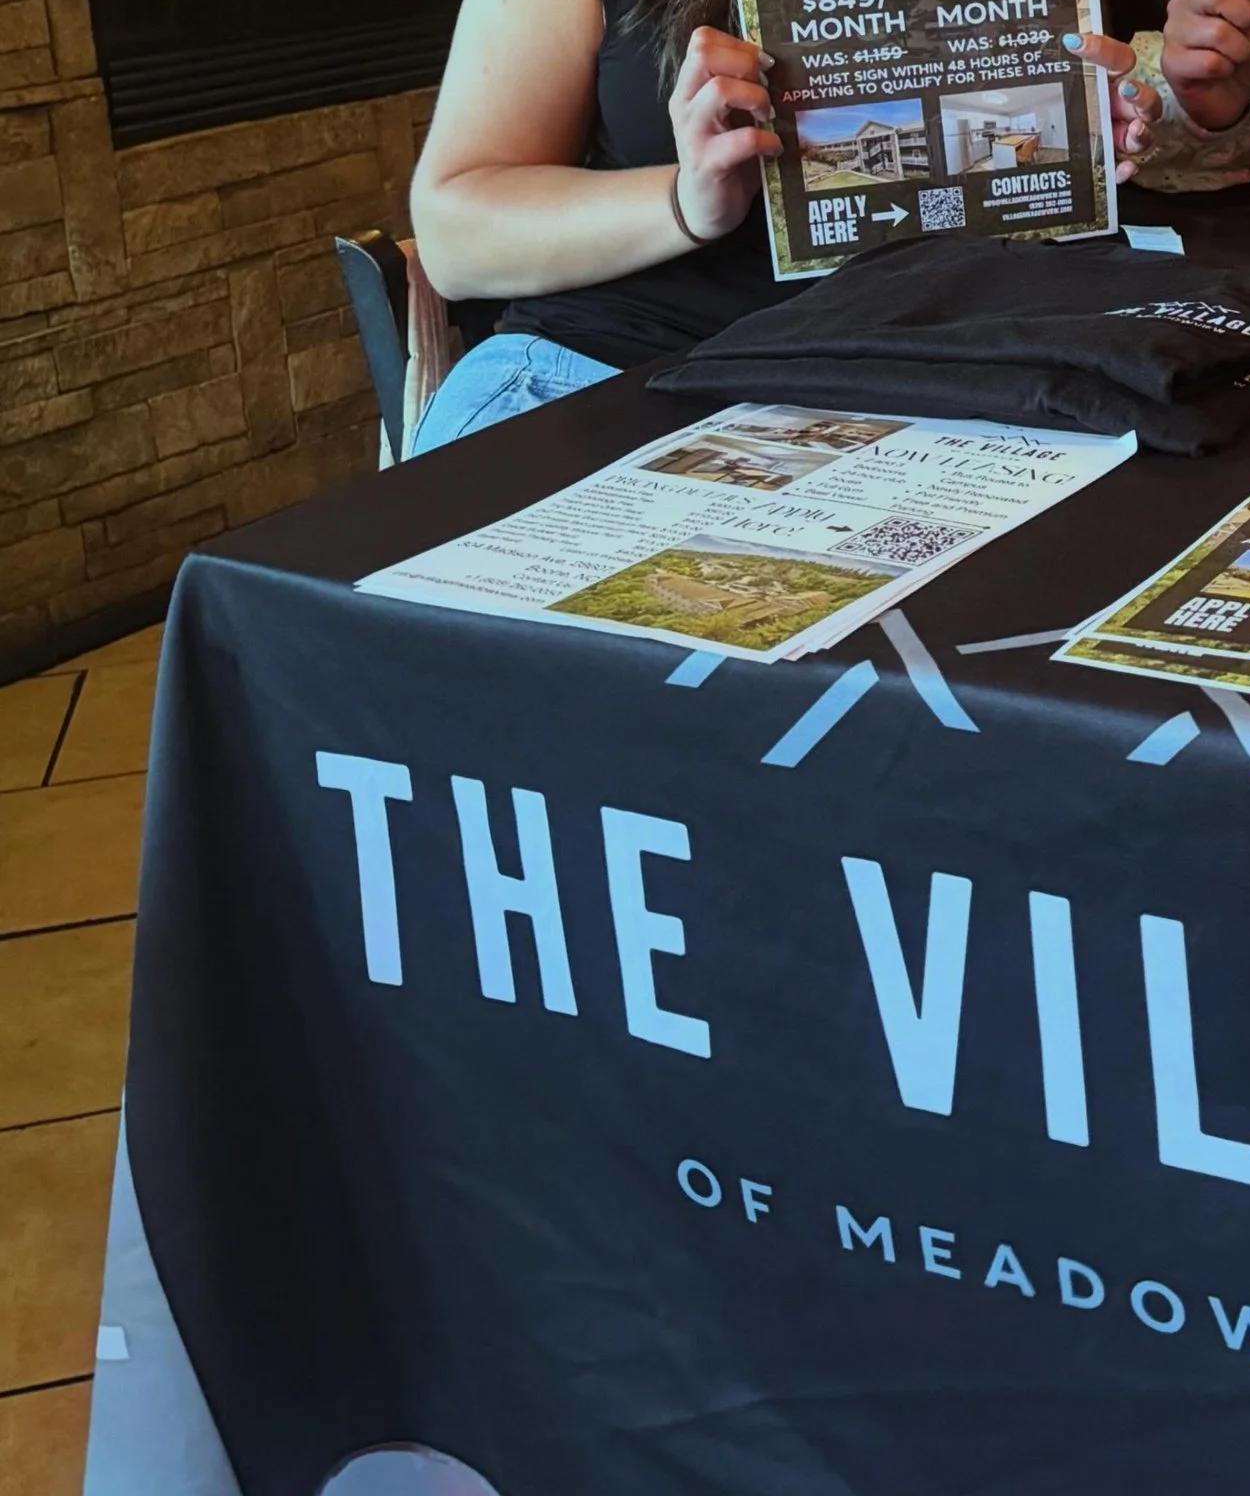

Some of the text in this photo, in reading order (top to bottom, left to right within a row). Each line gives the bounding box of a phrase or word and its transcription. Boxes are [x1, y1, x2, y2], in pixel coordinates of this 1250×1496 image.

[791, 10, 906, 45] MONTH
[947, 37, 993, 54] WAS:
[801, 52, 849, 69] WAS:
[808, 51, 1042, 87] MUST SIGN WITHIN 48 HOURS OF
[782, 60, 1072, 104] APPLYING TO QUALIFY FOR THESE RATES
[991, 170, 1071, 196] CONTACTS:
[808, 195, 867, 224] APPLY
[810, 219, 860, 247] HERE
[933, 436, 974, 449] THE
[980, 441, 1067, 461] VILLAGE
[940, 456, 1076, 485] LEASING!
[720, 515, 804, 536] Here!
[754, 502, 836, 522] Apply
[1164, 610, 1244, 633] HERE
[312, 750, 713, 1059] THE
[676, 1156, 773, 1223] OF
